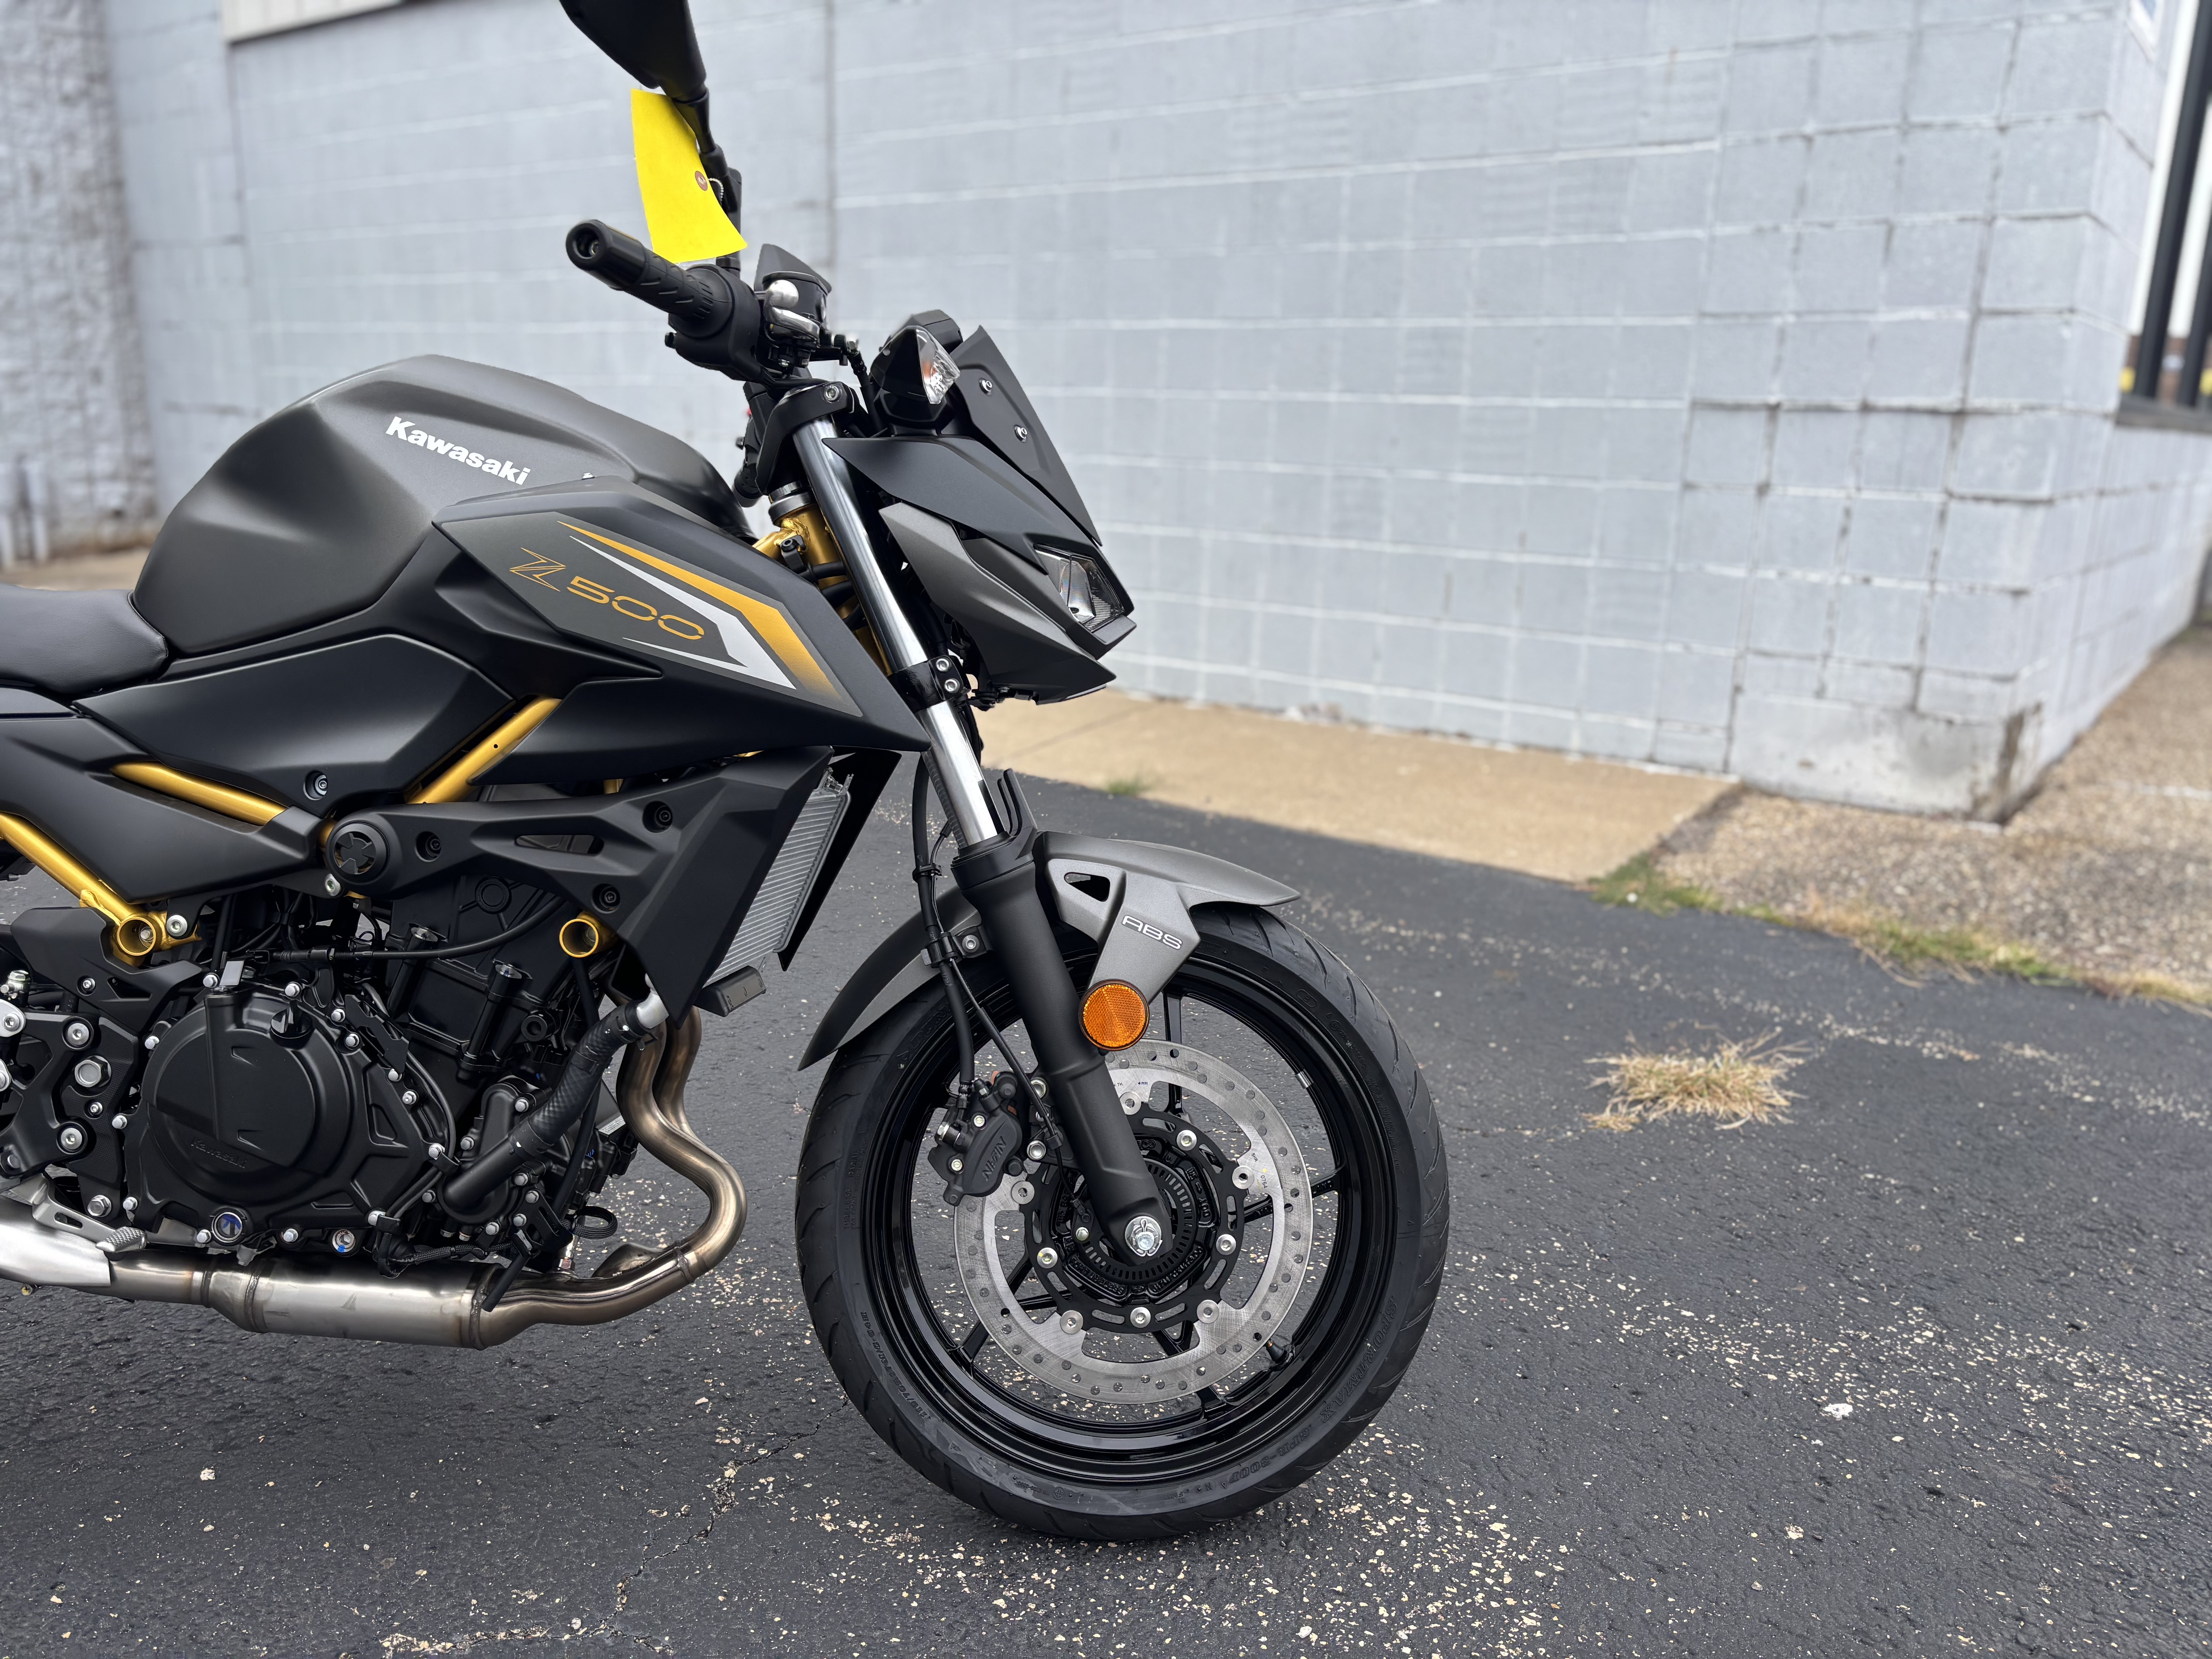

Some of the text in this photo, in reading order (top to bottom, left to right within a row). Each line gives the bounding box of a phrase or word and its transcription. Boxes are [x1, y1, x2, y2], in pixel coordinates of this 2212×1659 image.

[386, 416, 531, 485] Kawasaki
[1122, 915, 1183, 950] ABS
[190, 1137, 248, 1169] Kawasaki
[1319, 1296, 1398, 1423] SPORTMAX
